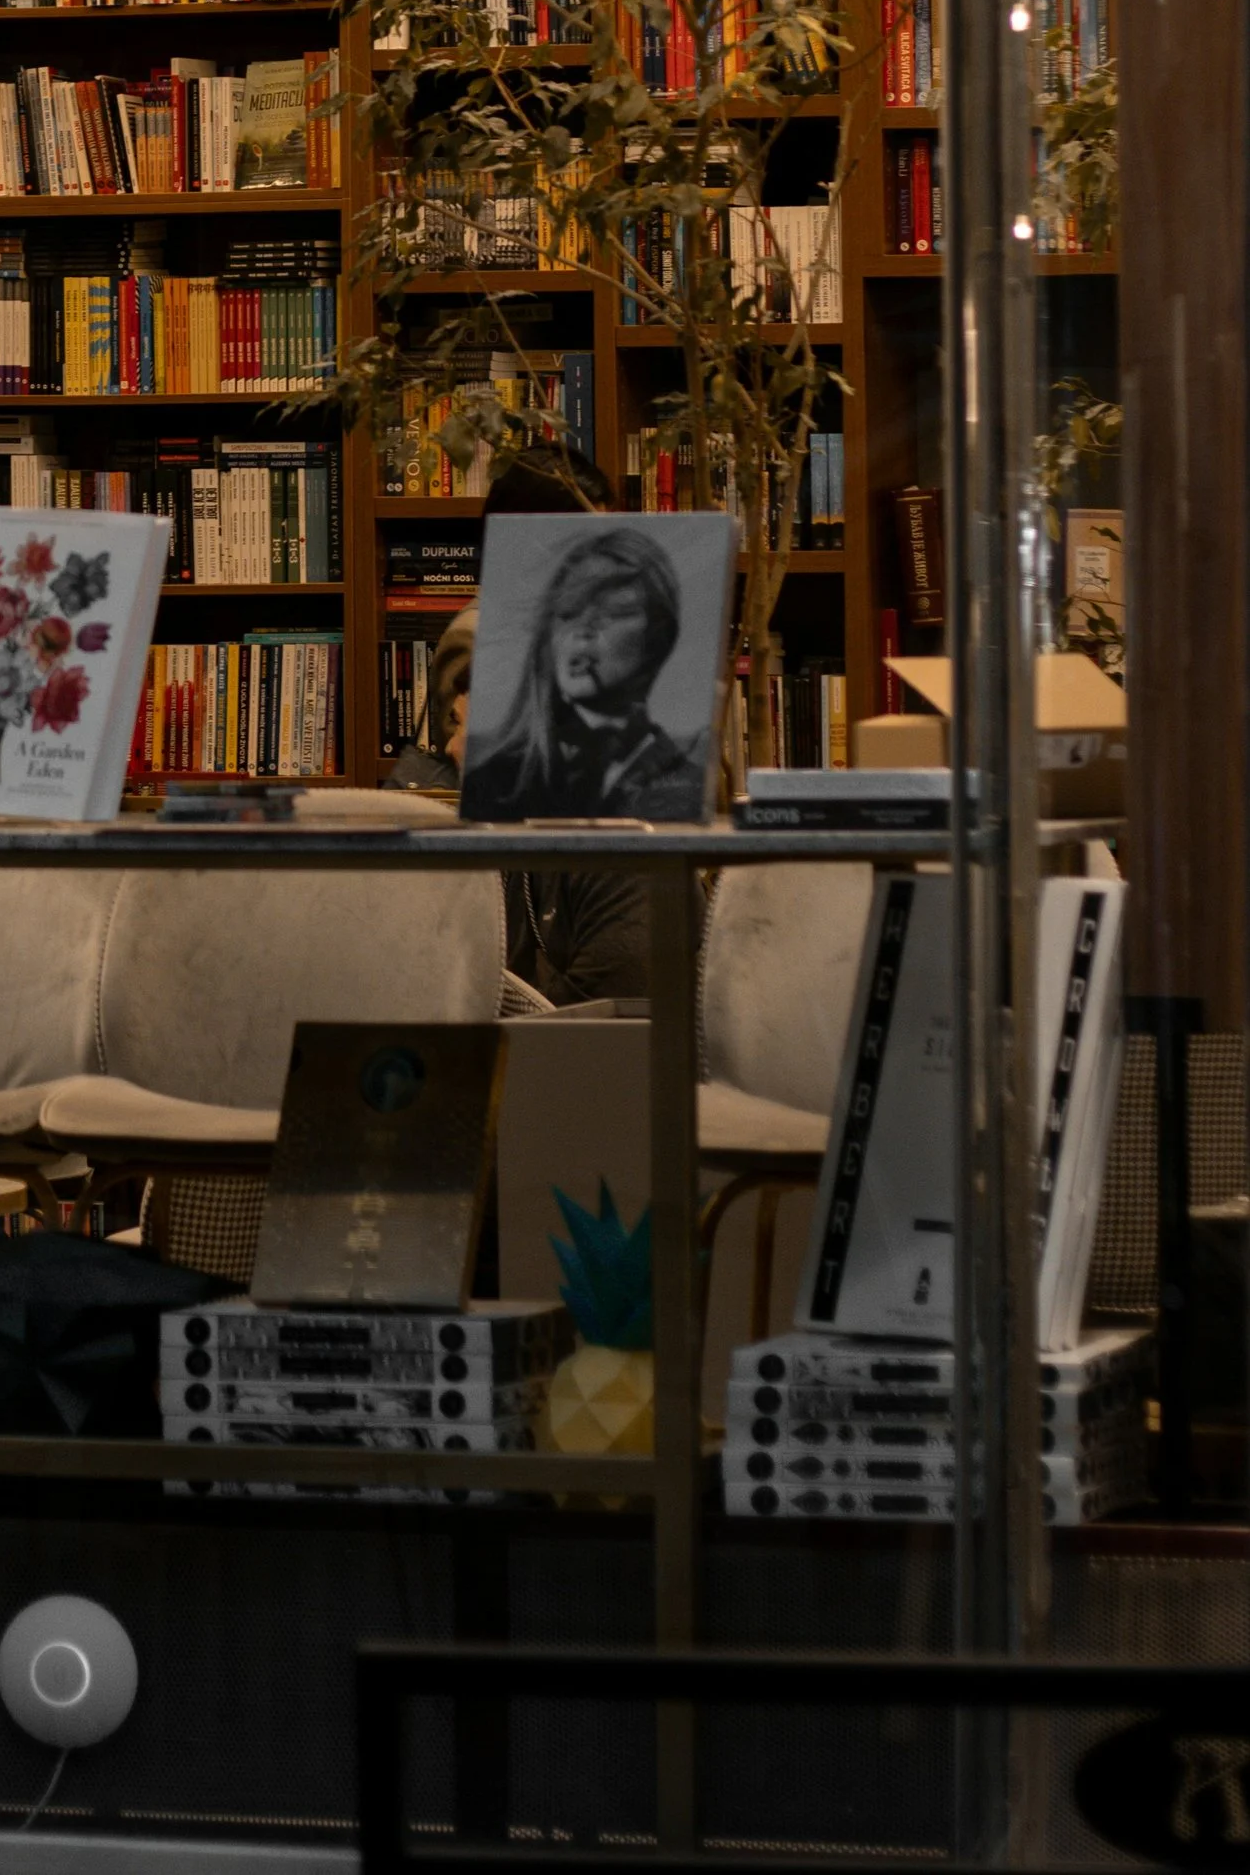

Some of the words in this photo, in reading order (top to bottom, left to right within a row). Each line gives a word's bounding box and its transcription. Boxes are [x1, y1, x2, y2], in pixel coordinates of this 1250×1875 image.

[910, 504, 923, 539] ЉУБАВ
[421, 546, 475, 557] DUPLIKAT
[423, 573, 451, 582] NOĆNI
[913, 552, 928, 588] ЖИВОТ
[145, 689, 154, 702] MIT
[144, 711, 154, 760] NORMALNOM
[239, 740, 247, 764] ŽIVOTA
[822, 908, 906, 1294] HERBERT
